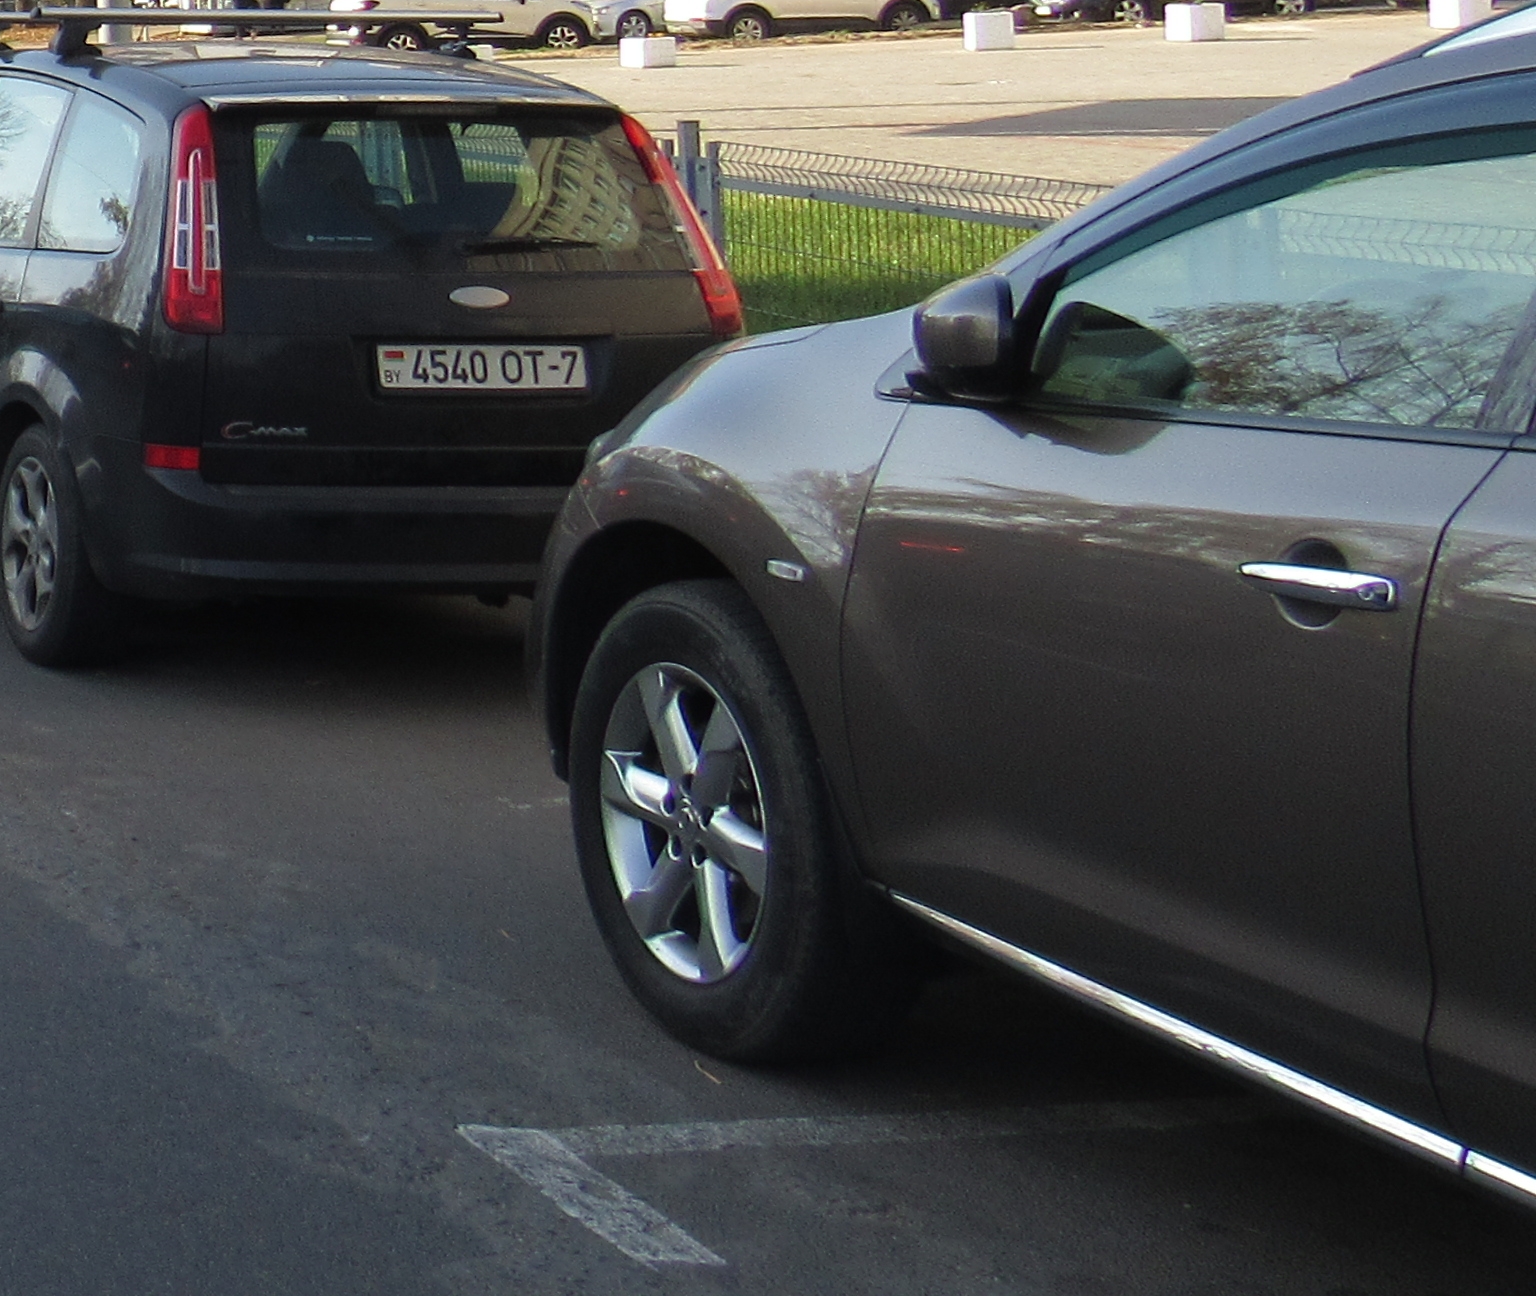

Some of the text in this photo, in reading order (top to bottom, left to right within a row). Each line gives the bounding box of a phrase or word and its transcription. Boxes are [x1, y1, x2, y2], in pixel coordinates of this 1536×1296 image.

[384, 369, 401, 384] BY
[411, 349, 579, 385] 4540 OT-7
